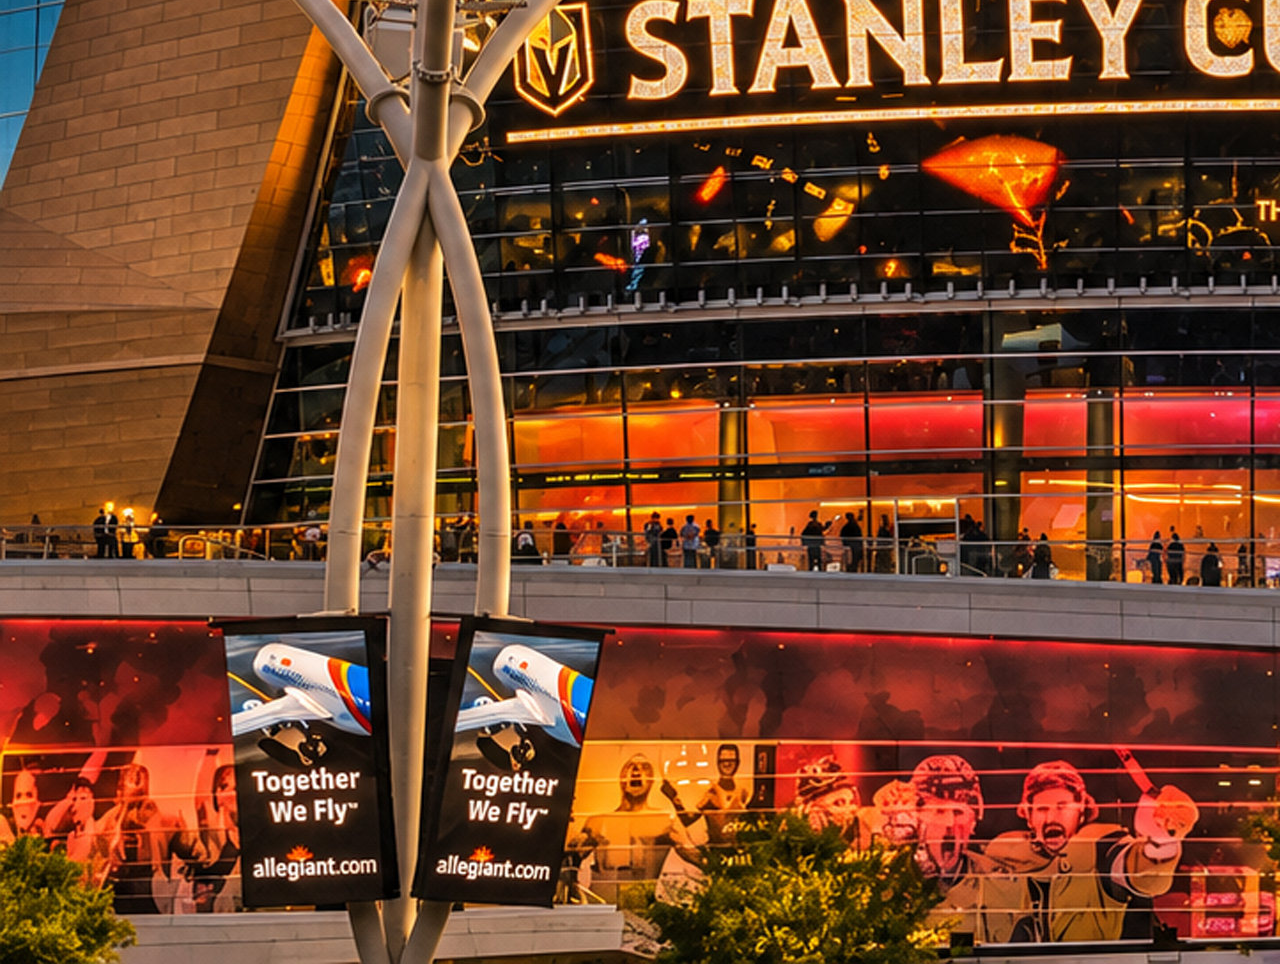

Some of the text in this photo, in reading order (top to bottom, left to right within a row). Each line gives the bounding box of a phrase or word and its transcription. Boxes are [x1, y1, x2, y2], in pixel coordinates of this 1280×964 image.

[252, 767, 360, 796] Together
[462, 768, 559, 797] Together
[269, 800, 307, 823] We
[468, 800, 501, 822] We
[253, 856, 377, 881] allegiant.com
[436, 855, 550, 880] allegiant.com
